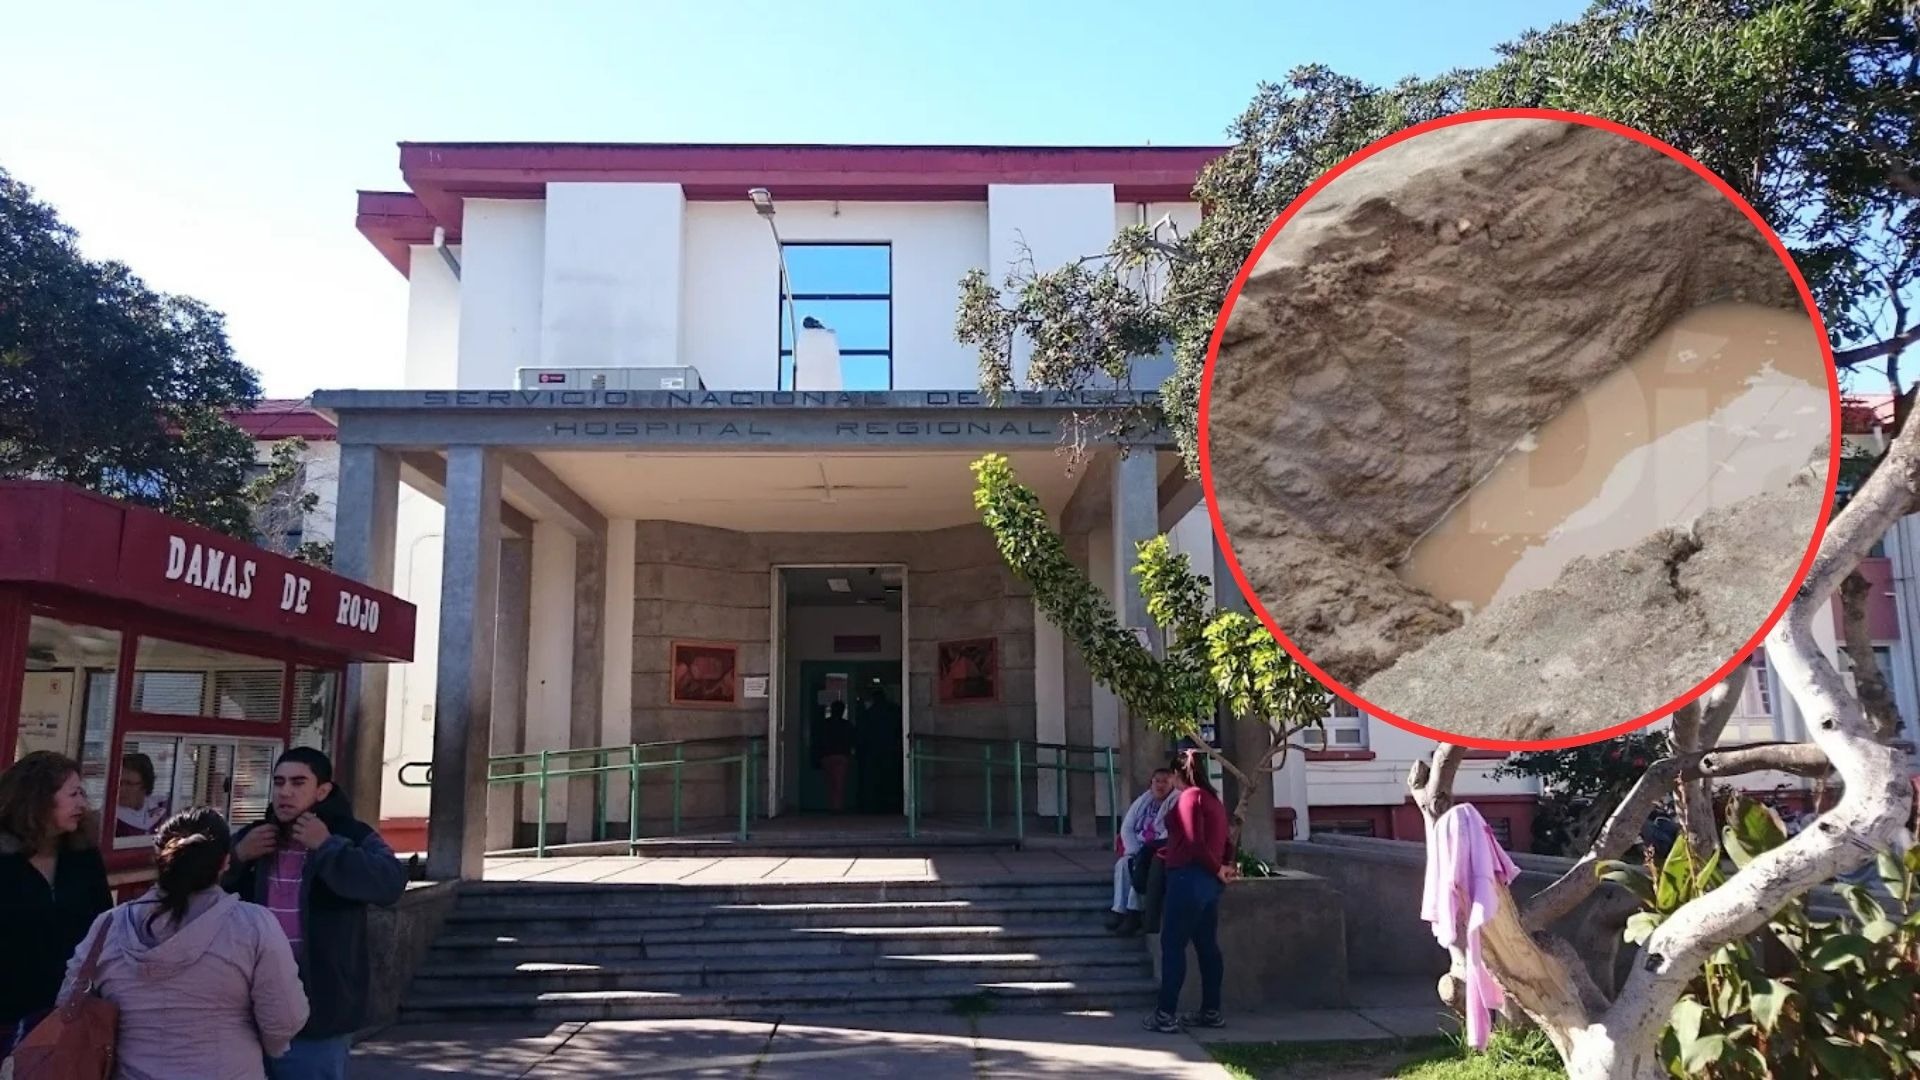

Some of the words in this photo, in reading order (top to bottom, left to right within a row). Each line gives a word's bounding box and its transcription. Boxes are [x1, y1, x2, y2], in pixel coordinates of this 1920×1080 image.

[423, 391, 628, 406] SERVICIO
[668, 391, 888, 406] NACIONAL
[926, 391, 980, 406] DE
[553, 421, 772, 437] HOSPITAL
[835, 421, 1053, 436] REGIONAL
[165, 535, 257, 600] DAMAS
[280, 572, 312, 615] DE
[336, 590, 380, 634] ROJO
